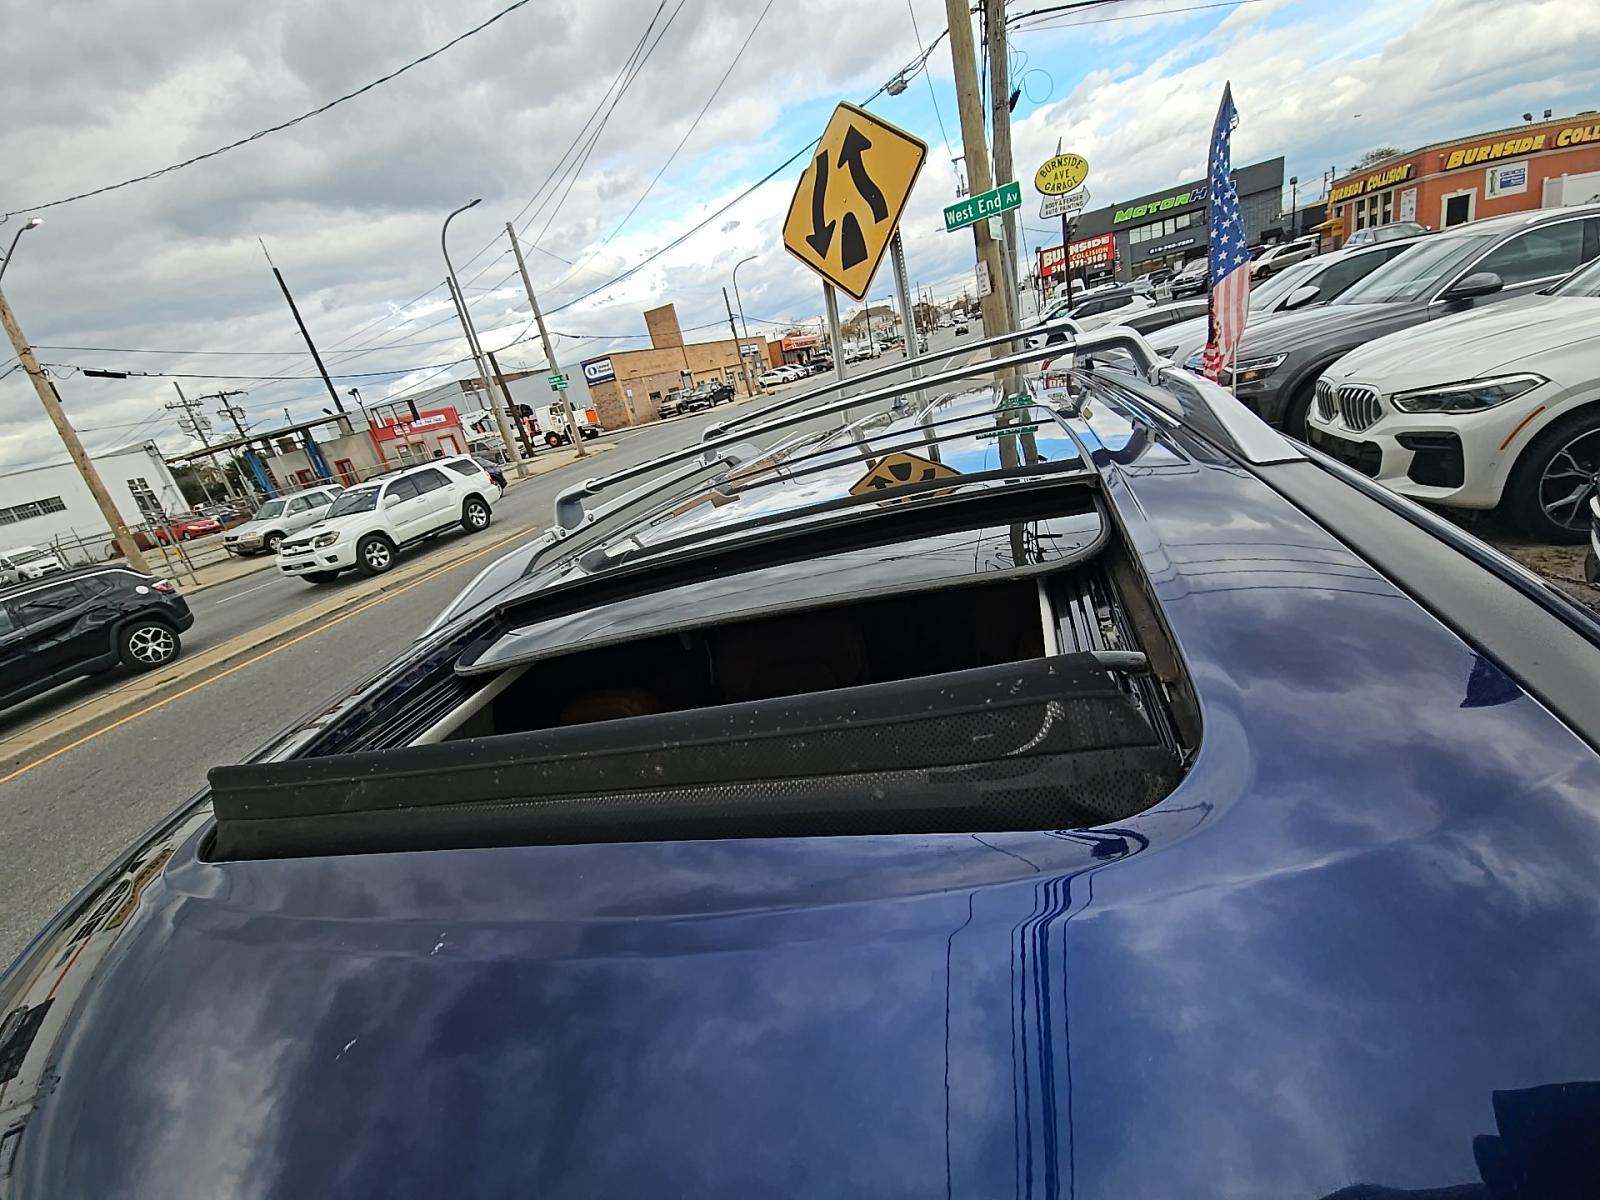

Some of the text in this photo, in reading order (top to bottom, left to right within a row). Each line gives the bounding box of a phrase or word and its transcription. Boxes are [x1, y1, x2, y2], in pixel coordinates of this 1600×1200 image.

[1445, 134, 1546, 169] BURNSIDE
[1040, 157, 1083, 178] BURNSIDE
[1053, 169, 1070, 181] AVE
[1045, 176, 1077, 192] GARAGE
[946, 203, 974, 225] West
[978, 189, 1001, 213] End
[1072, 247, 1108, 260] COLLISION
